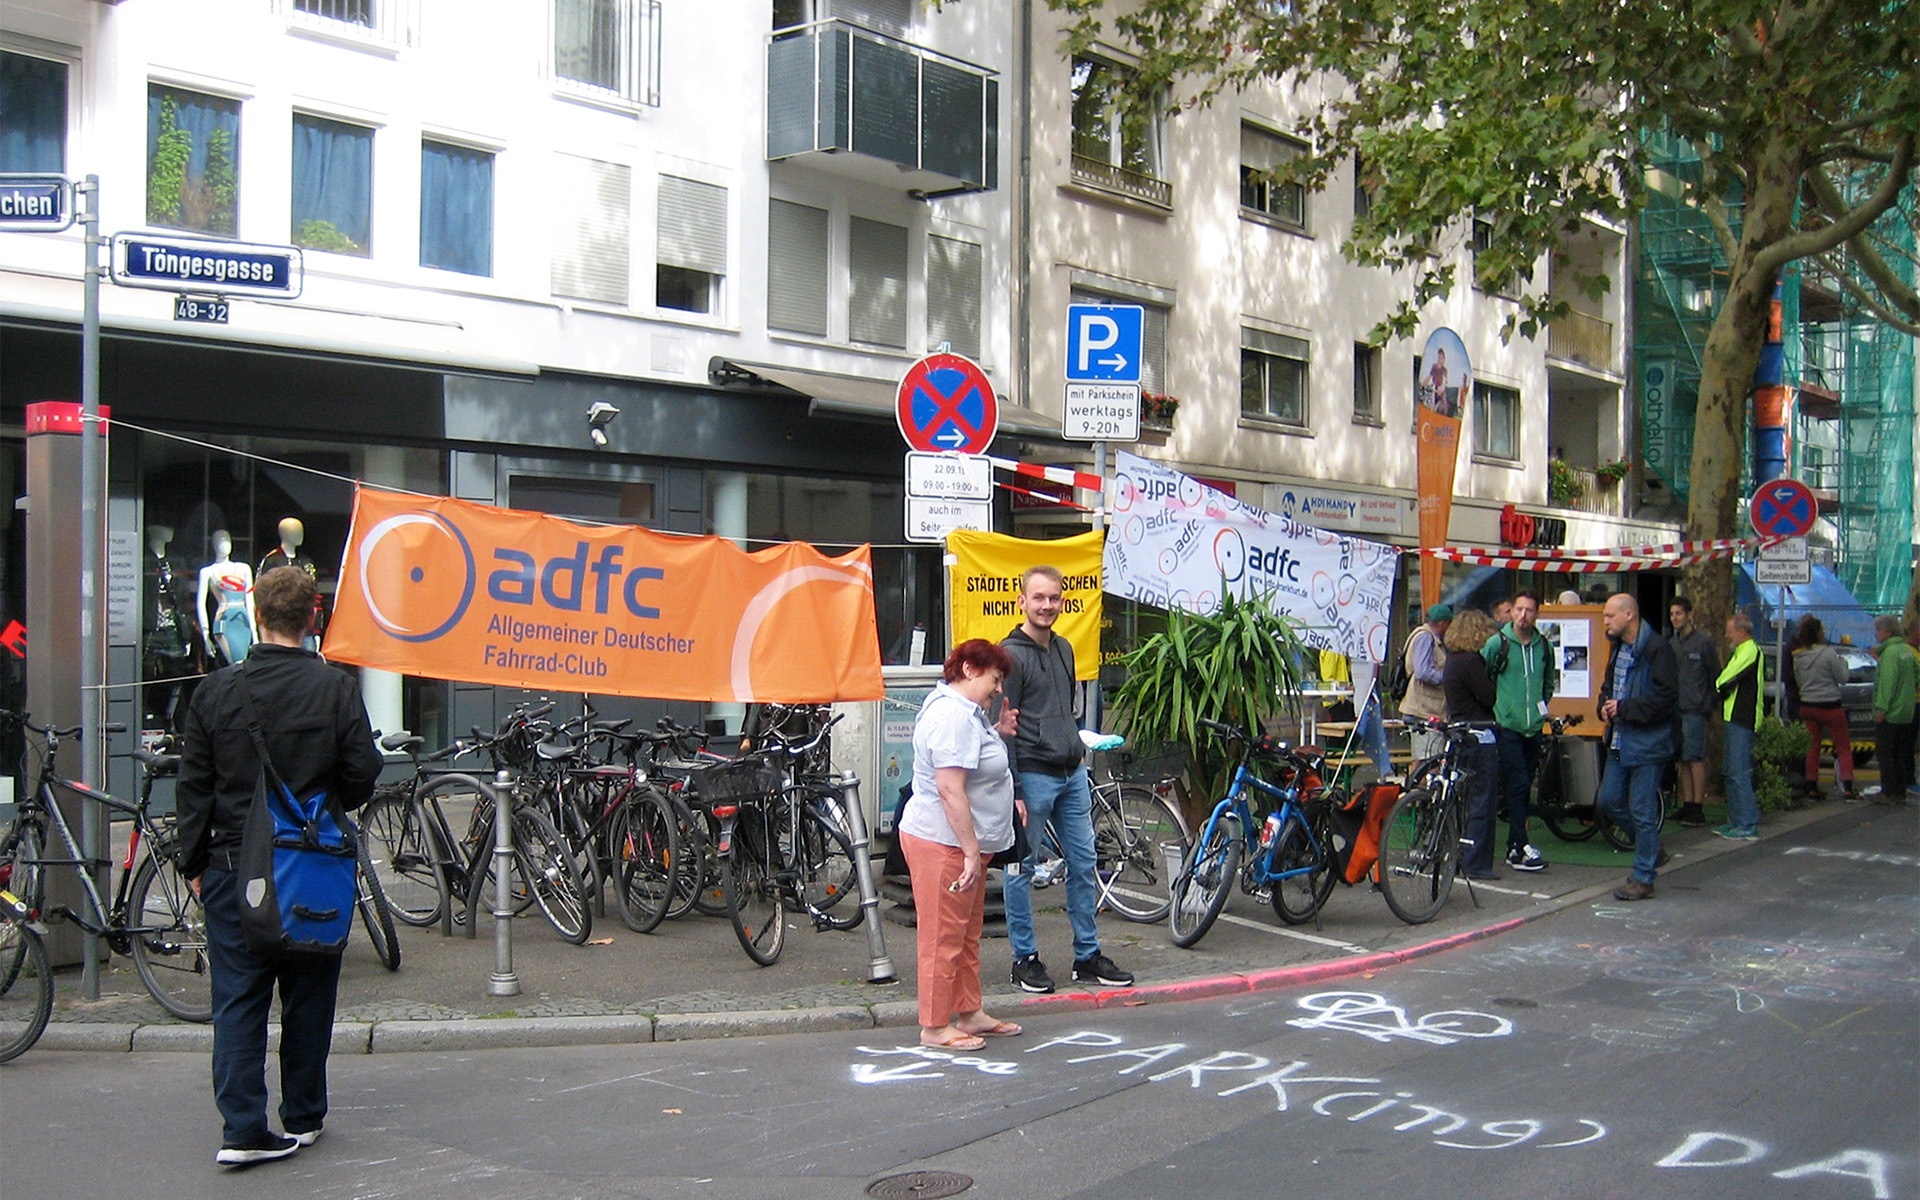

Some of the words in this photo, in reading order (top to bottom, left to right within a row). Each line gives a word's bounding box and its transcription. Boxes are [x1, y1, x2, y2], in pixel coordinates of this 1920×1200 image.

[142, 246, 275, 283] Töngesgasse
[178, 301, 228, 322] 48-32
[1078, 315, 1119, 371] P
[1070, 390, 1084, 399] mit
[1088, 388, 1134, 400] Parkschein
[1070, 406, 1133, 420] werktags
[1082, 421, 1120, 434] 9-20h
[1647, 388, 1664, 463] othello
[1138, 477, 1177, 501] adfc
[928, 505, 949, 515] auch
[951, 506, 962, 516] im
[1146, 508, 1178, 529] adfc
[1174, 519, 1201, 553] adfc
[1281, 519, 1313, 540] adfc
[1249, 545, 1300, 582] adfc
[488, 542, 664, 619] adfc
[967, 574, 1009, 593] STÄDTE
[983, 601, 1016, 617] NICHT
[487, 614, 599, 645] Allgemeiner
[604, 627, 695, 653] Deutscher
[484, 645, 607, 677] Fahrrad-Club
